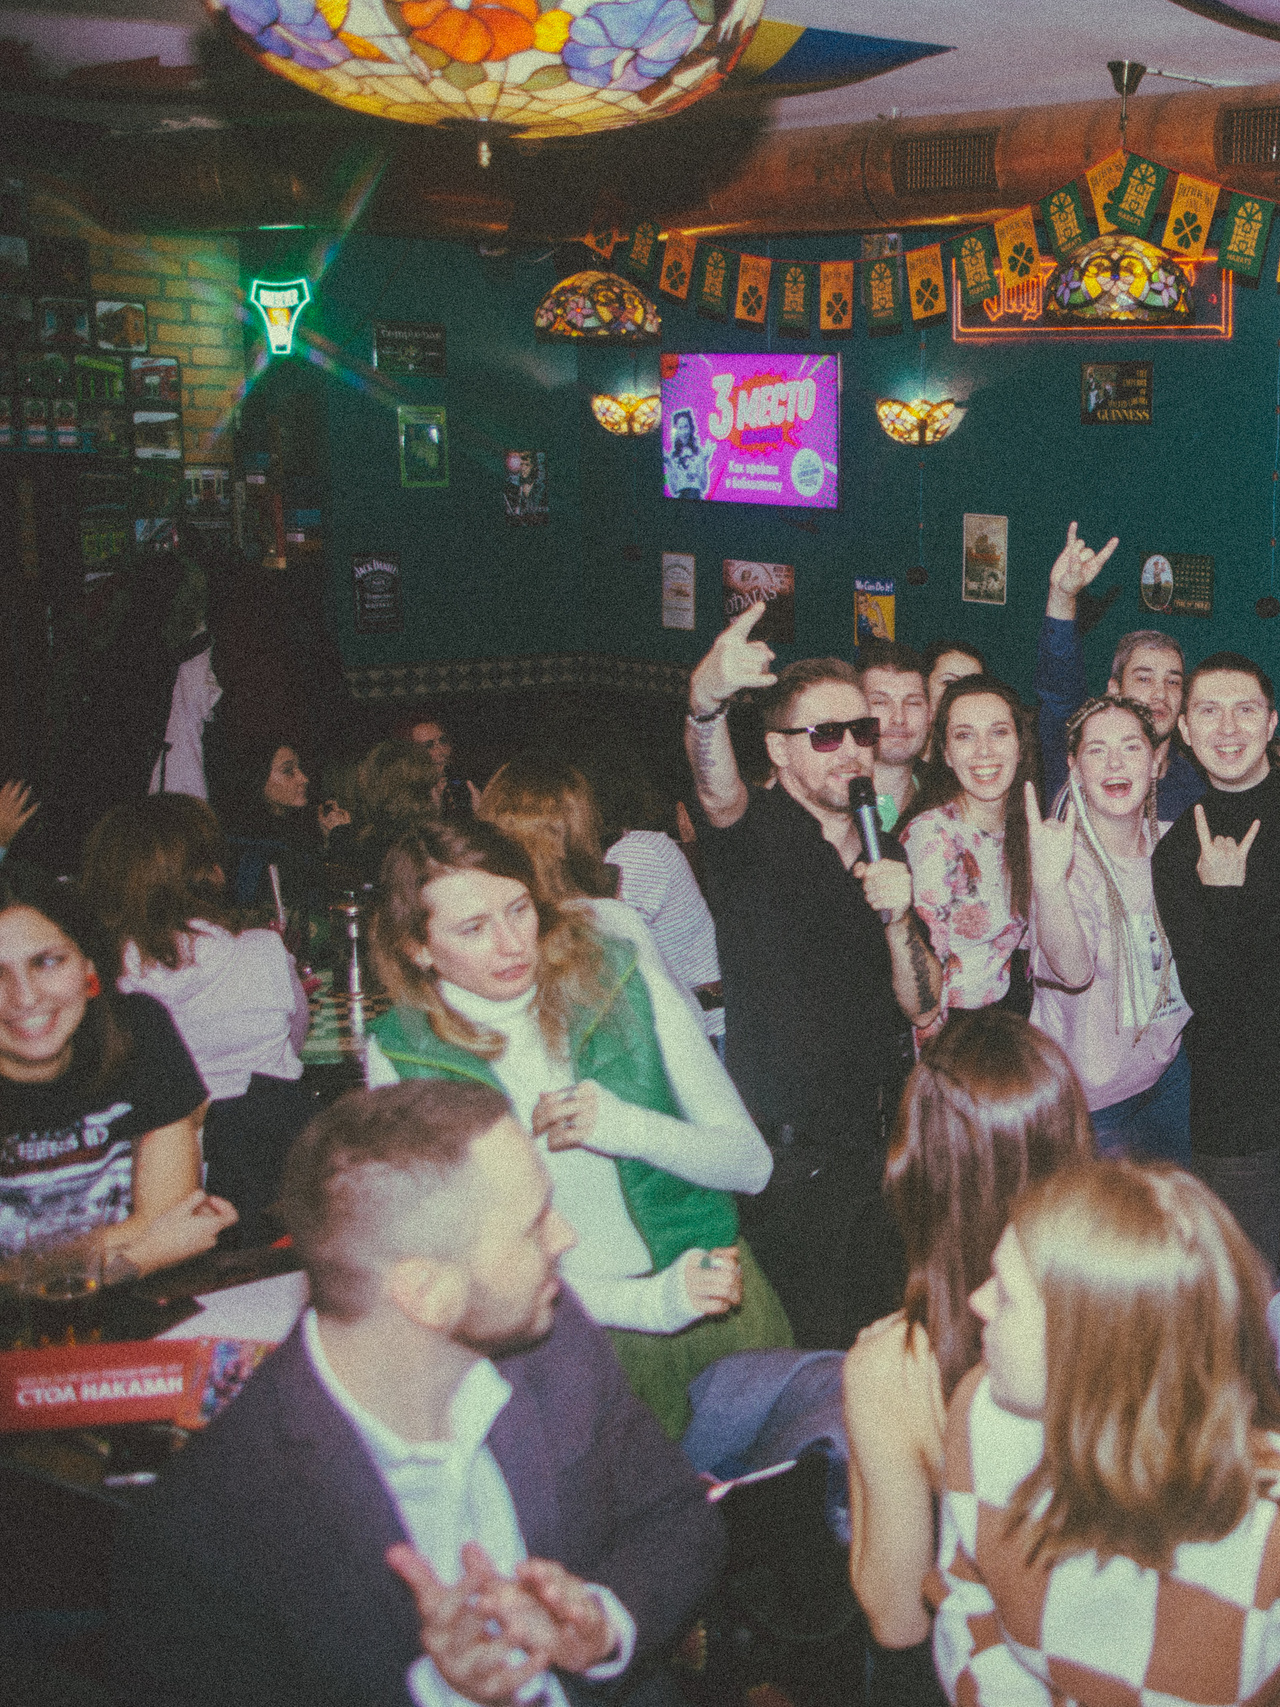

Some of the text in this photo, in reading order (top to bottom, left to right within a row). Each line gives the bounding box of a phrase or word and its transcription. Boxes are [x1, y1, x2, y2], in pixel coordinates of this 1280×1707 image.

[708, 373, 816, 440] 3 МЕСТО
[1097, 409, 1150, 421] GUINNESS
[17, 1376, 184, 1408] СТОЛ НАКАЗАН
